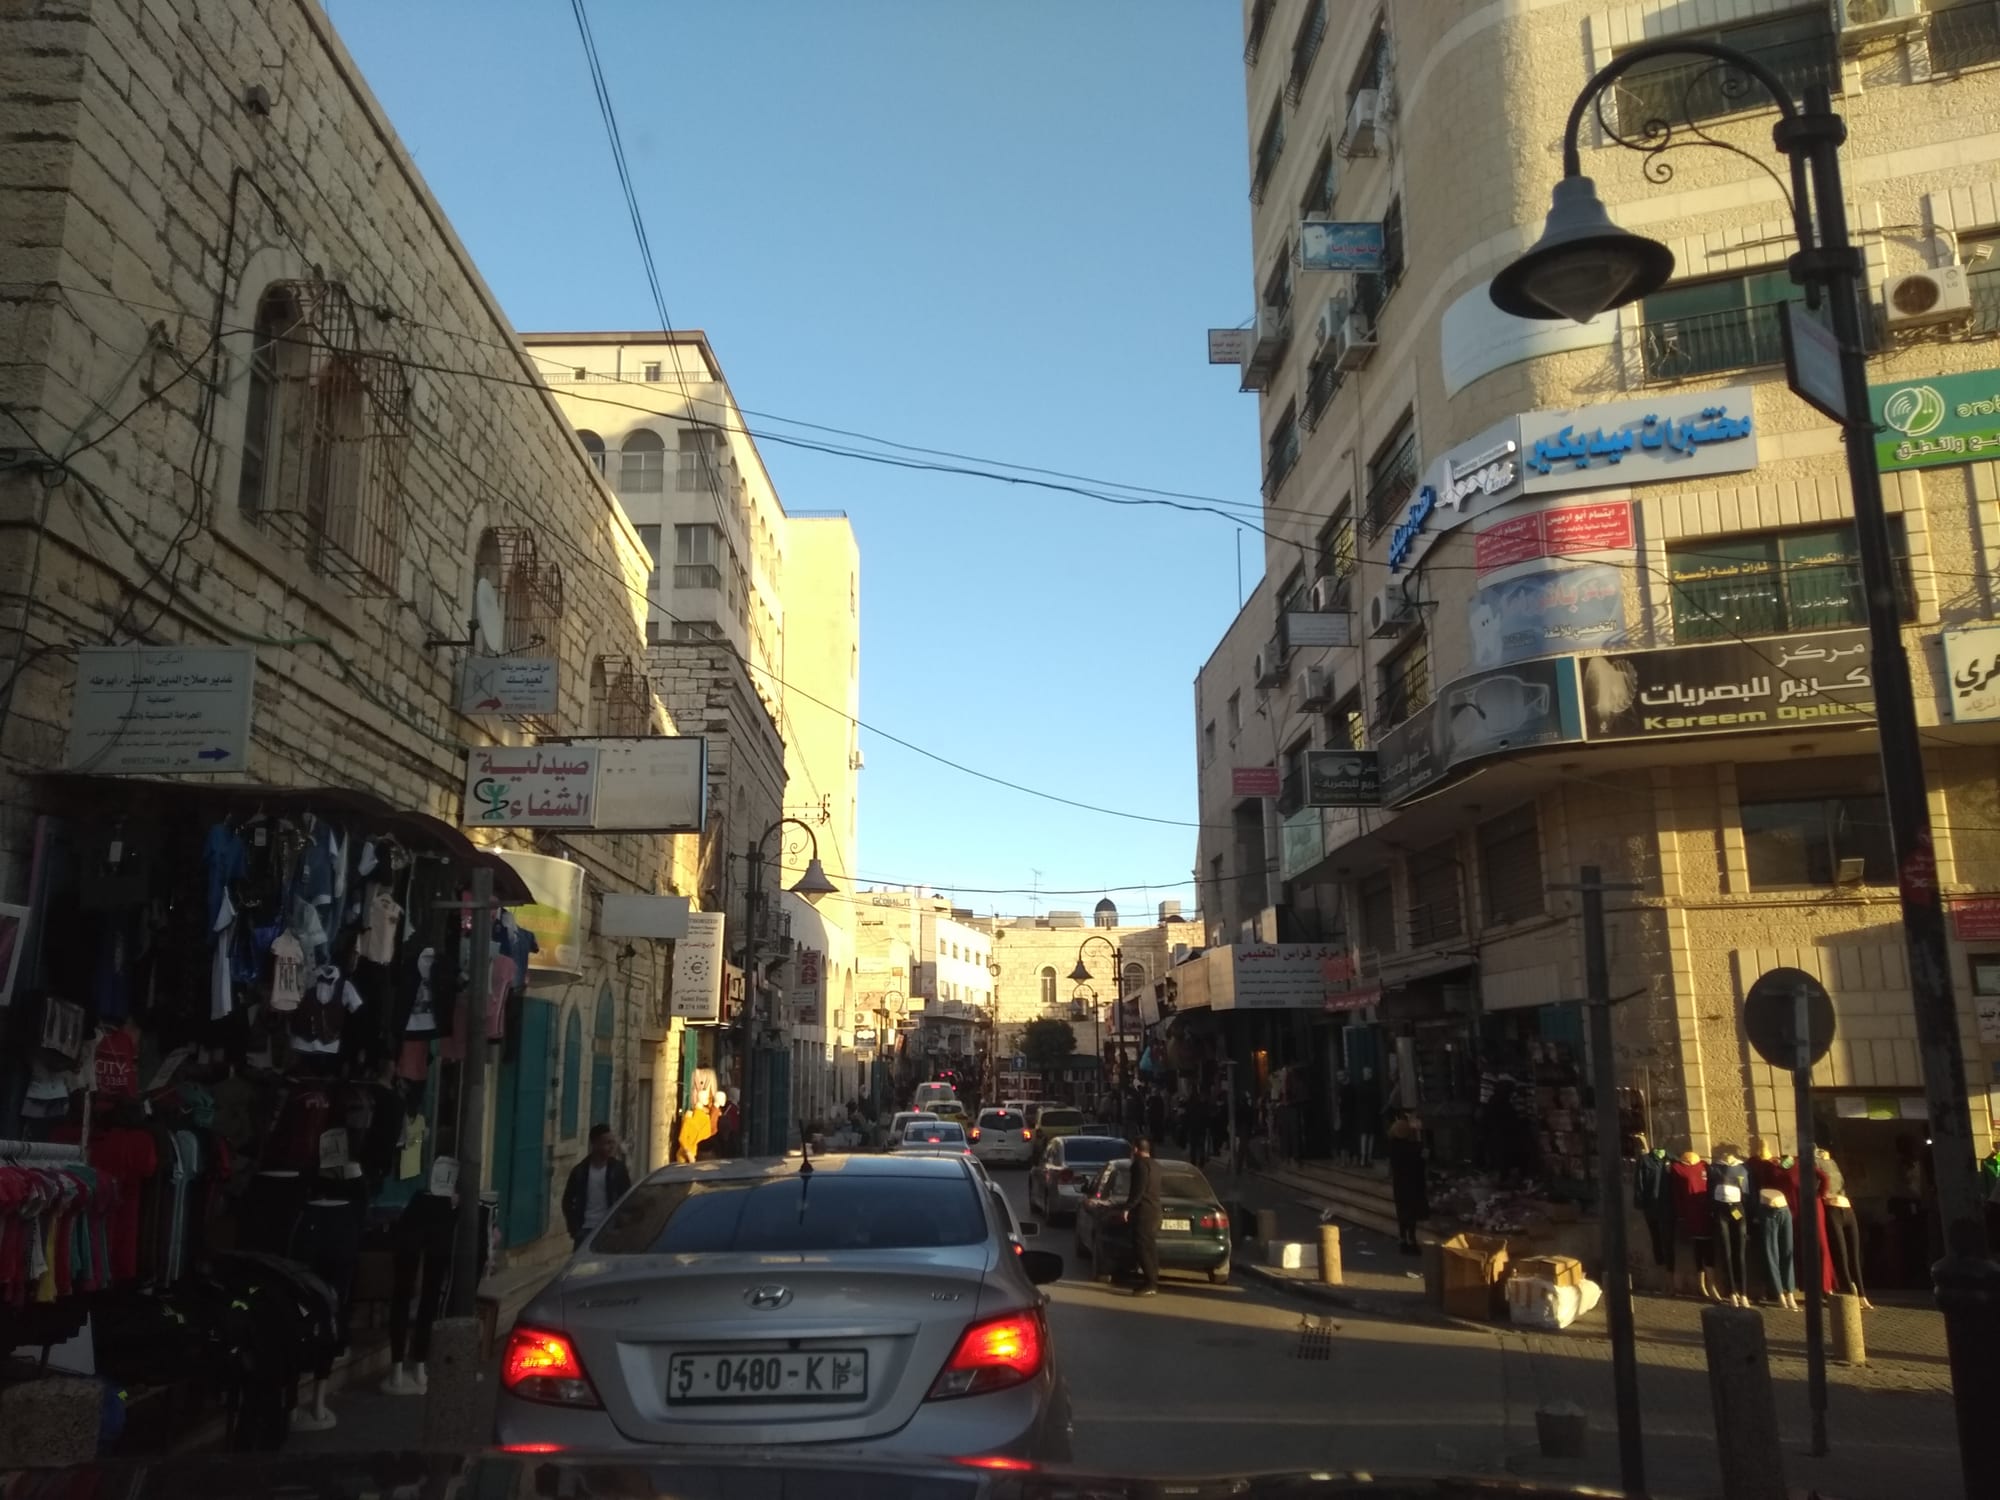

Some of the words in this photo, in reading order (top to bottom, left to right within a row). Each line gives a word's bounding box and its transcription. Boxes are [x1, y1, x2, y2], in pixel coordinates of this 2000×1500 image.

[1641, 406, 1753, 458] مختبرات
[1895, 436, 1966, 461] والنطق
[1779, 642, 1867, 668] مركز
[1640, 677, 1772, 707] للبصريات
[1778, 667, 1872, 705] كريم
[1643, 712, 1767, 729] Kareem
[1776, 701, 1876, 721] Optics
[475, 751, 590, 782] صيدلية
[509, 786, 590, 819] الشفاء
